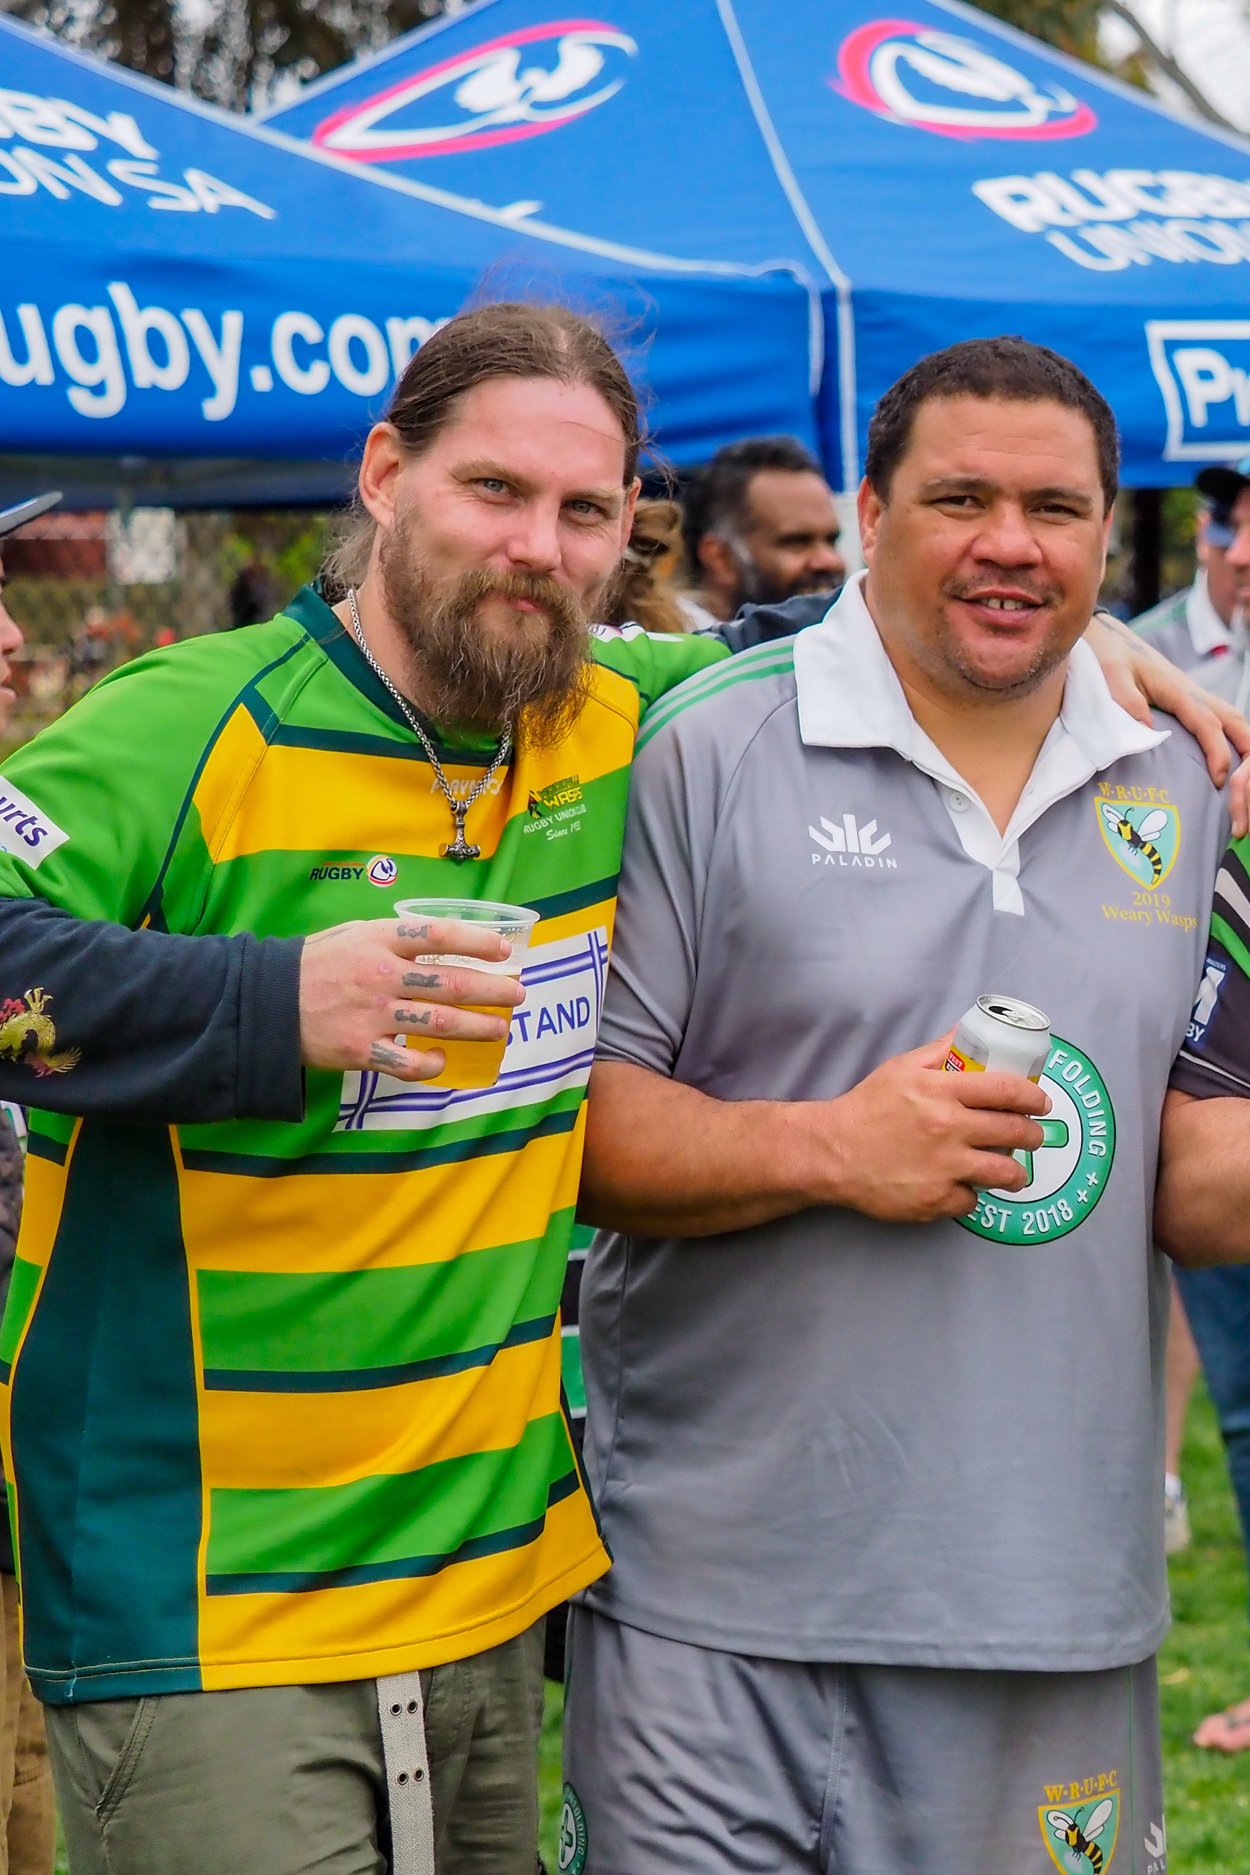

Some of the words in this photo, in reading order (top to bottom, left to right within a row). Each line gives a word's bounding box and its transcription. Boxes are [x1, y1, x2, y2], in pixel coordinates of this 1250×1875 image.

[0, 88, 160, 160] BY
[523, 816, 553, 834] RUGBY
[811, 853, 898, 868] PALADIN
[309, 867, 364, 881] RUGBY
[1132, 891, 1171, 908] 2019
[1101, 904, 1151, 925] Weary
[1022, 1198, 1074, 1236] 2018
